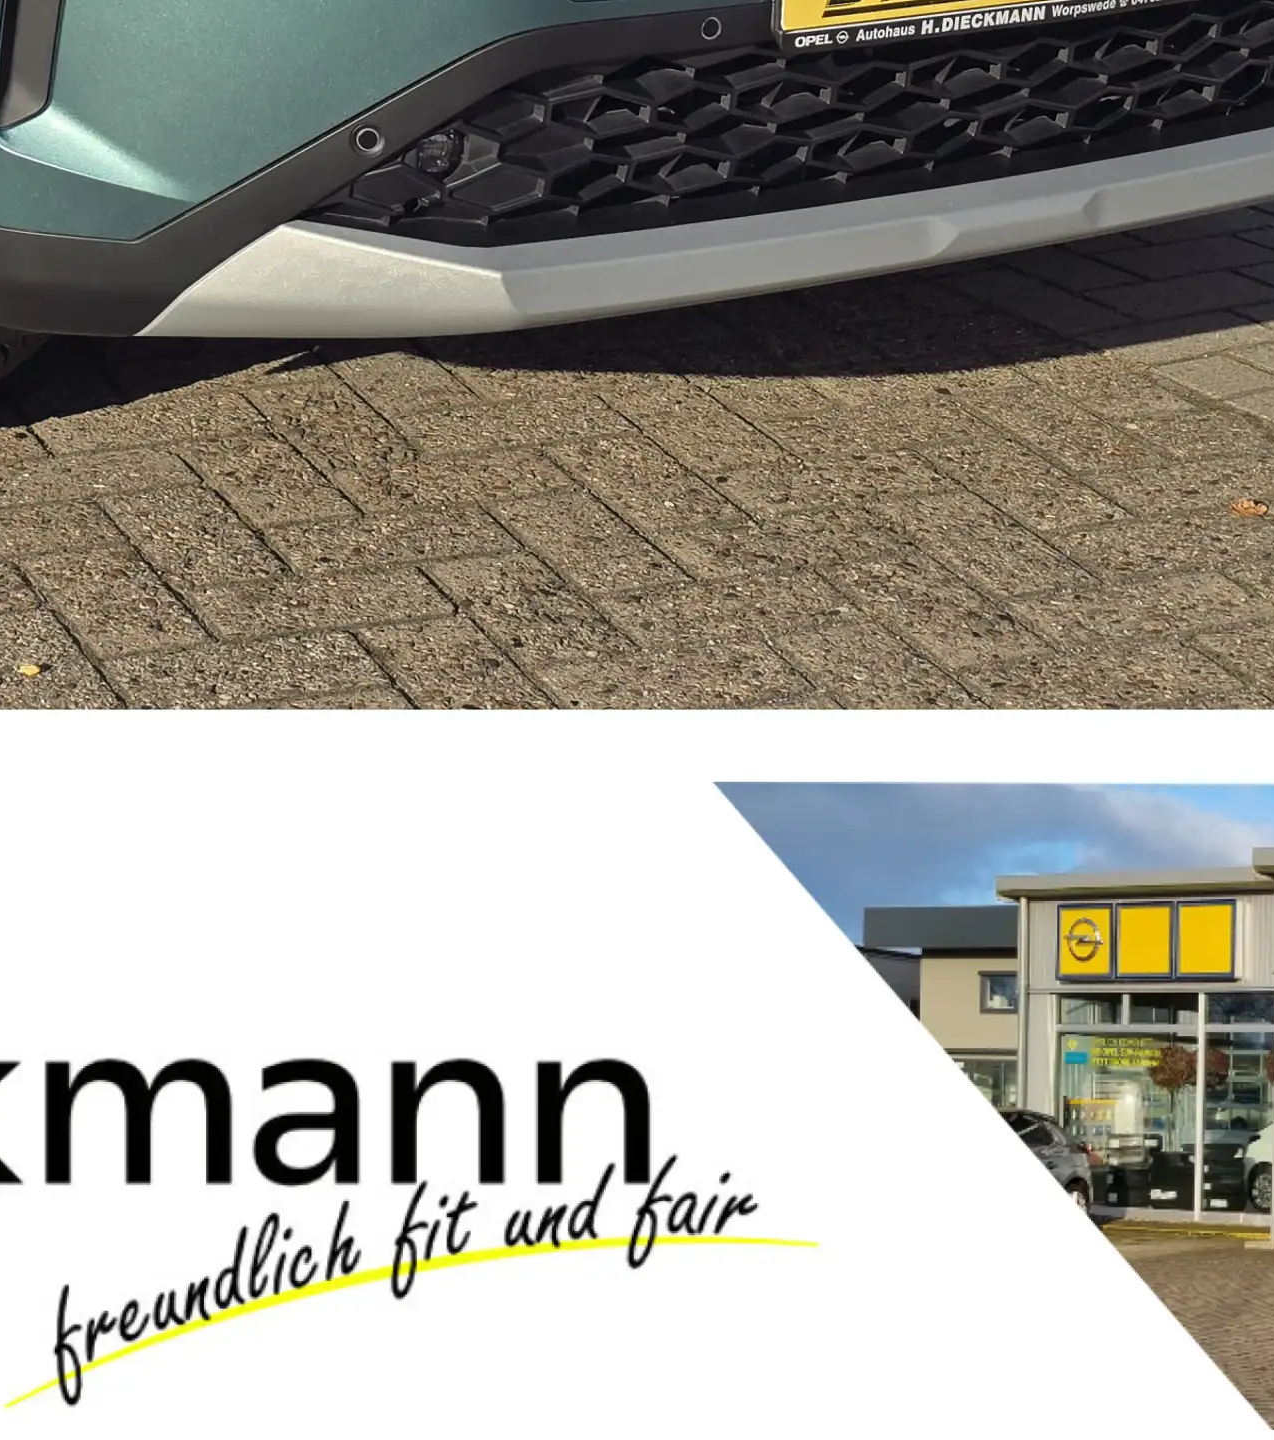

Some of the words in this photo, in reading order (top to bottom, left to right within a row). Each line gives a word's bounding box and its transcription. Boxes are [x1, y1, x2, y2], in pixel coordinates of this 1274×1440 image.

[794, 33, 834, 49] OPEL
[855, 23, 916, 43] Autohaus
[921, 5, 1046, 36] H.DIECKMANN
